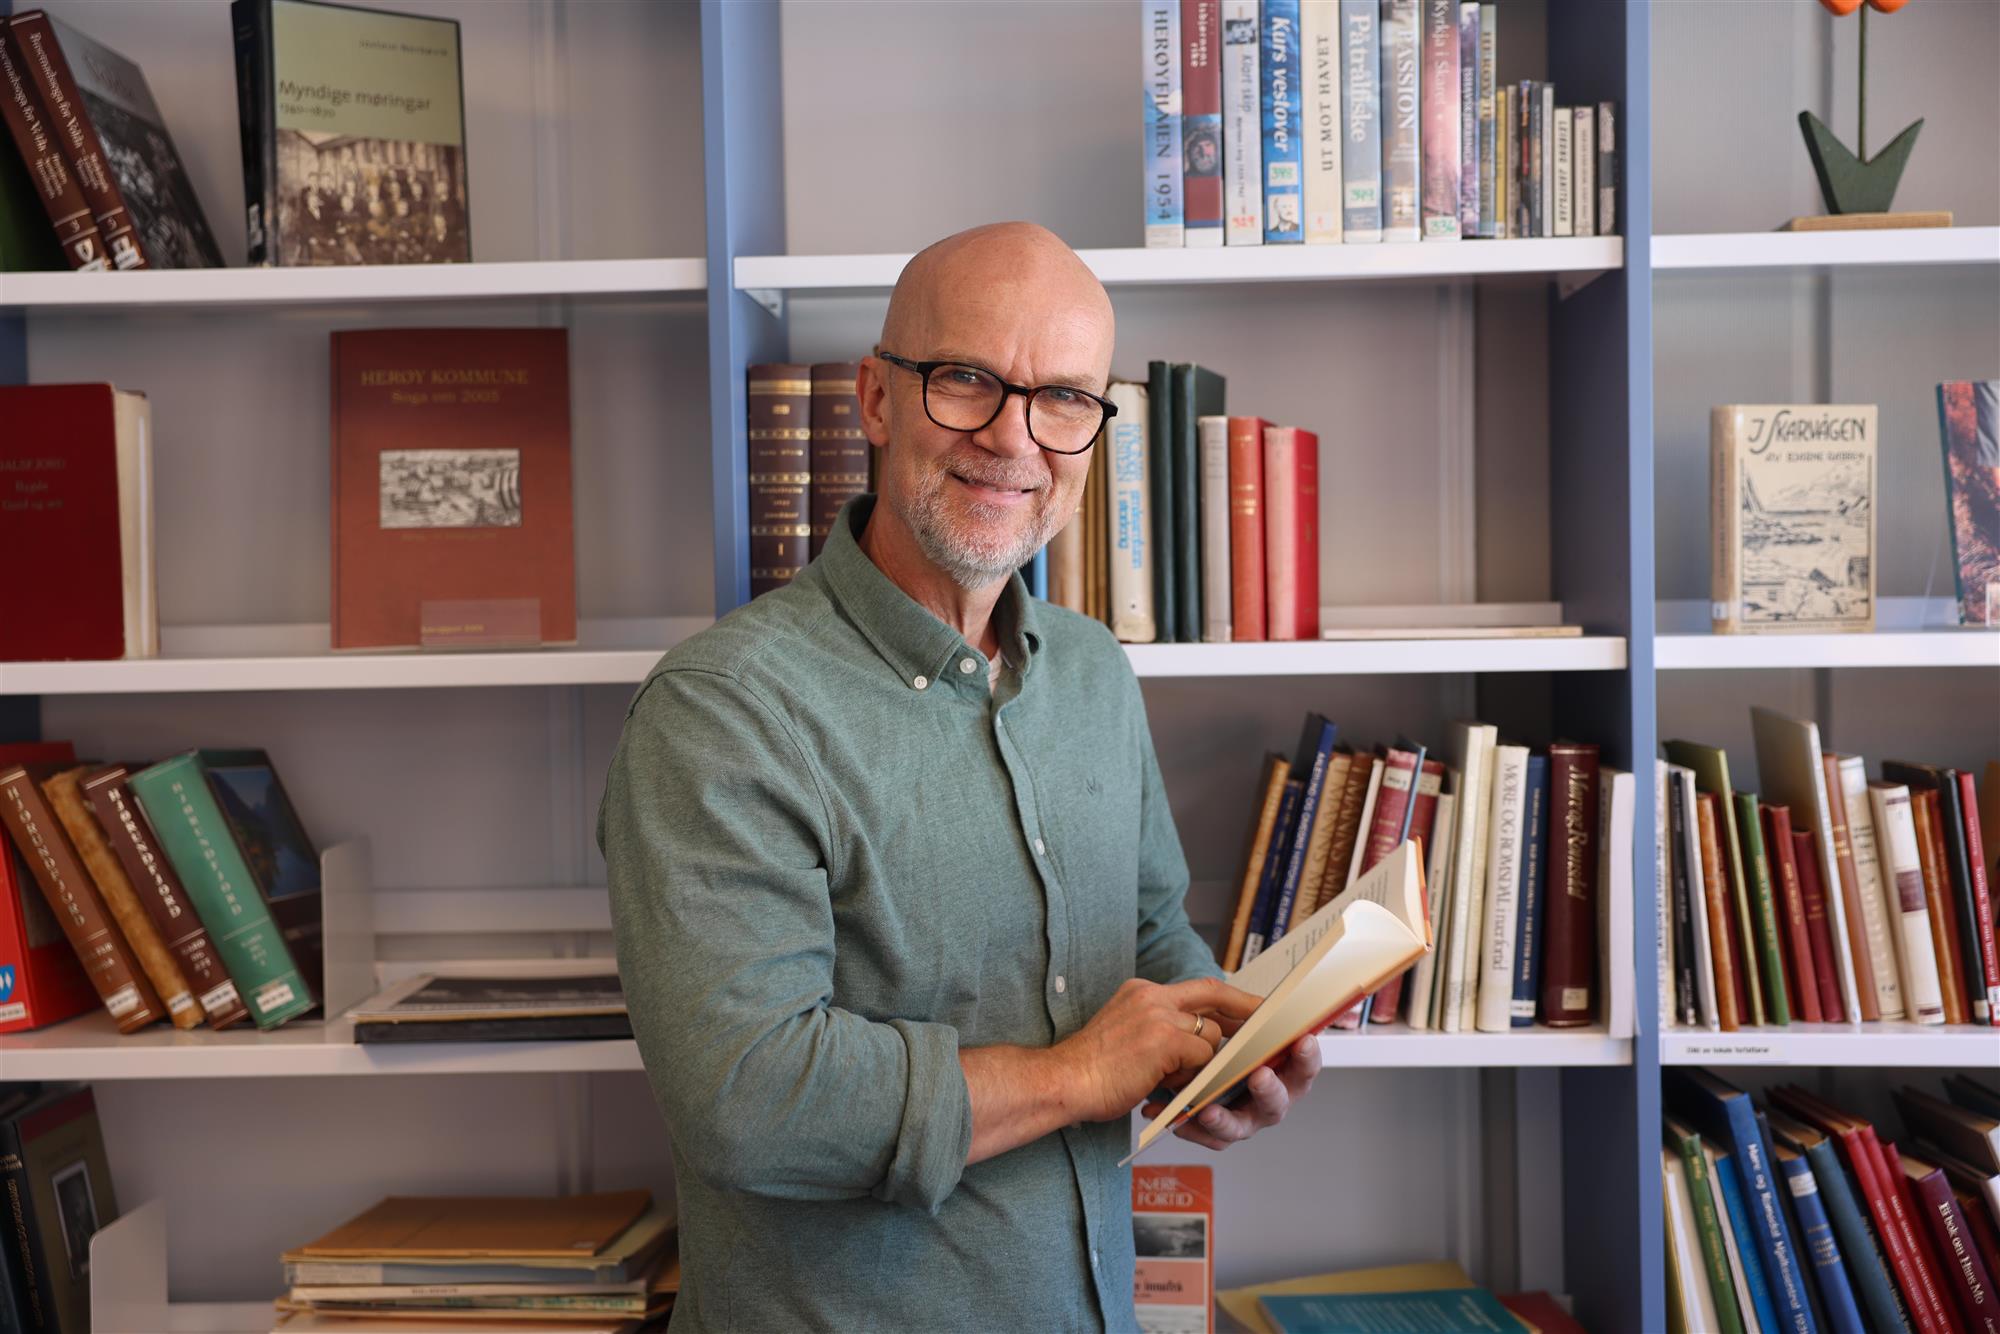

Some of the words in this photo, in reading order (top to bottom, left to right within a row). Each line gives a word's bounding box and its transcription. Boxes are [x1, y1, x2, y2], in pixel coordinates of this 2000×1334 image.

[1271, 16, 1291, 62] Kurs
[1432, 0, 1450, 47] Kyrkja
[1154, 10, 1172, 158] HERØYFILMEN
[1316, 36, 1331, 95] HAVET
[1397, 32, 1415, 129] PASSION
[280, 79, 351, 106] Myndige
[1272, 69, 1288, 152] vestover
[1319, 103, 1333, 146] MOT
[1321, 151, 1333, 171] UT
[1157, 174, 1172, 220] 1954
[431, 369, 529, 384] KOMMUNE
[1495, 836, 1515, 904] ROMSDAL
[1960, 1255, 1977, 1285] Hans
